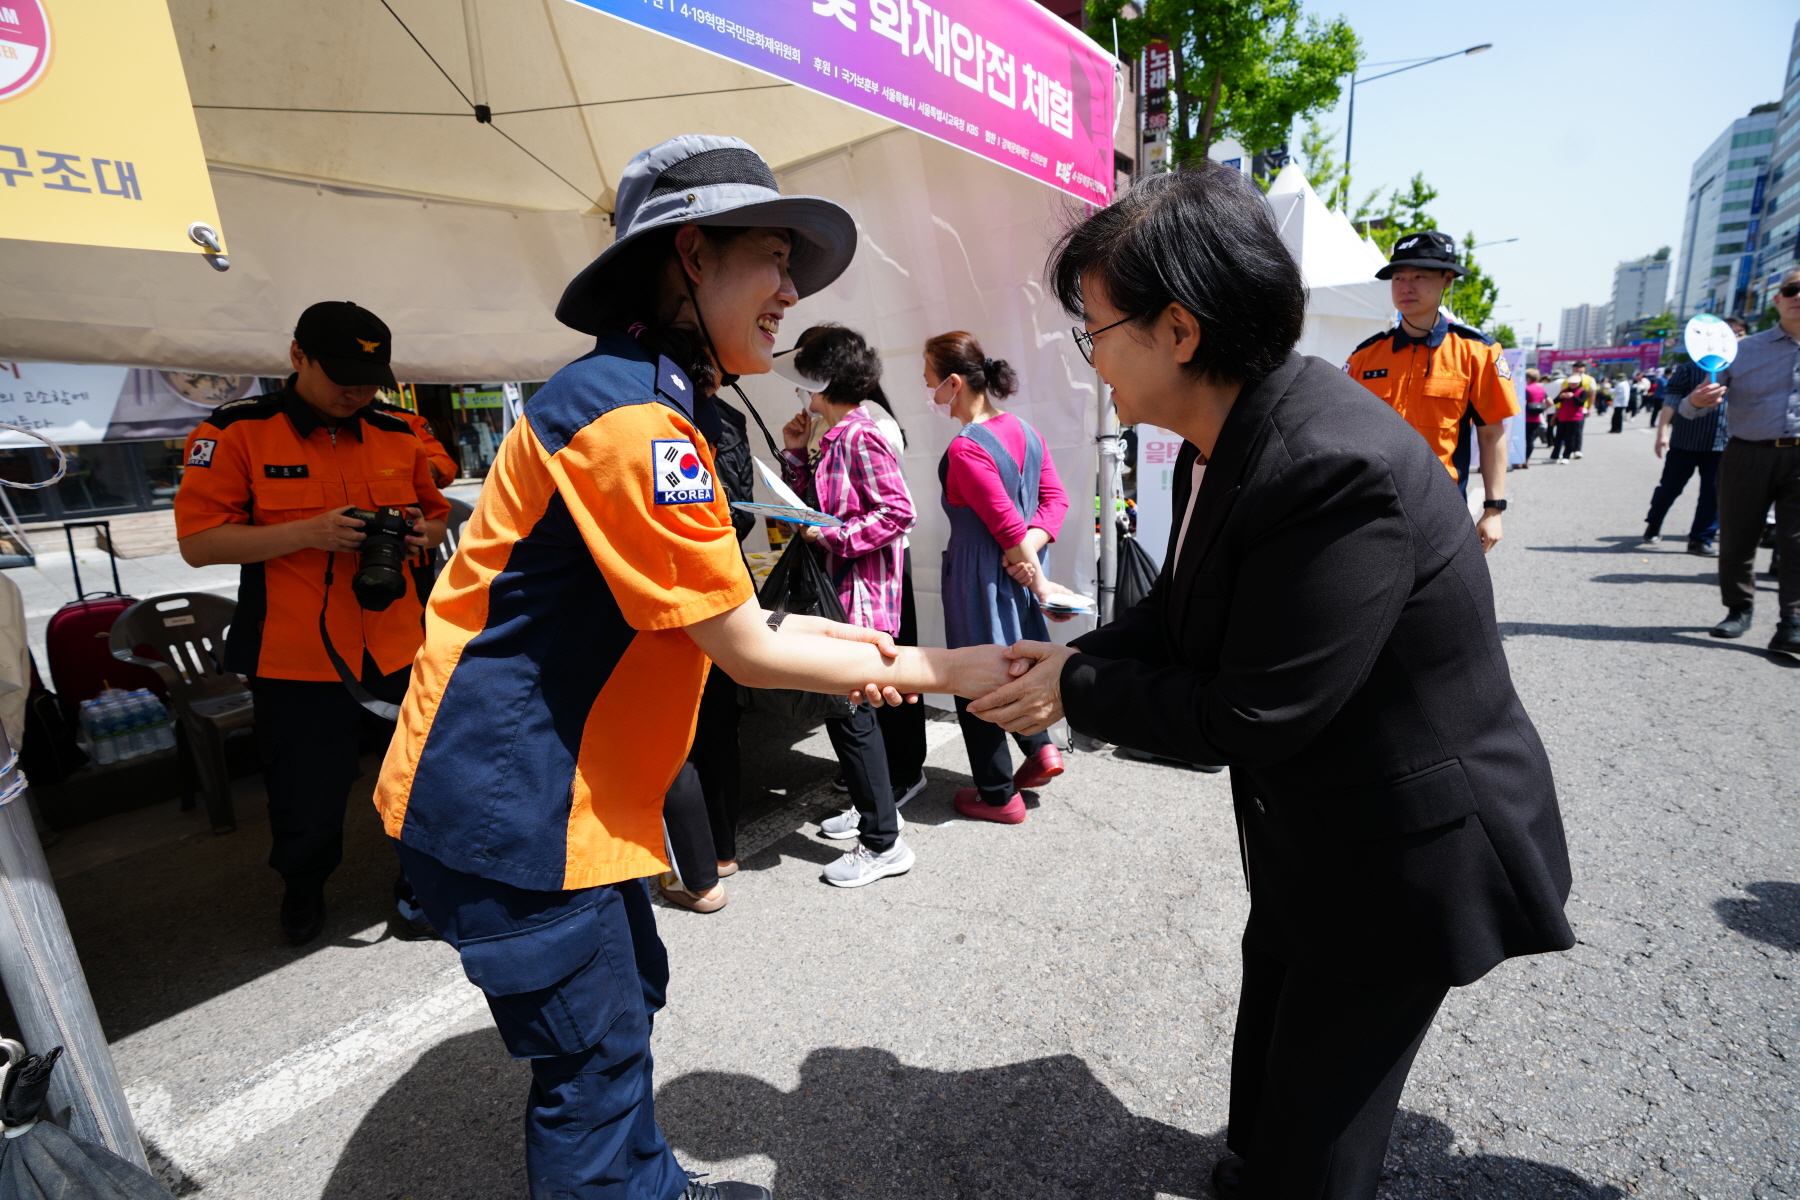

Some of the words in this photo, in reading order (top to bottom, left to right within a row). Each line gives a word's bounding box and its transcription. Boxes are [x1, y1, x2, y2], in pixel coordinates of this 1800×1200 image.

[869, 0, 1017, 110] 화재안전
[1022, 62, 1073, 140] 체험
[813, 56, 831, 77] 후원
[841, 68, 879, 95] 국가보훈부
[881, 86, 916, 111] 서울특별시
[917, 101, 965, 132] 서울특별시교육청
[966, 122, 980, 138] KBS
[984, 129, 996, 146] 협찬
[0, 144, 143, 201] 구조대
[22, 389, 91, 407] 고소함에
[664, 488, 711, 502] KOREA
